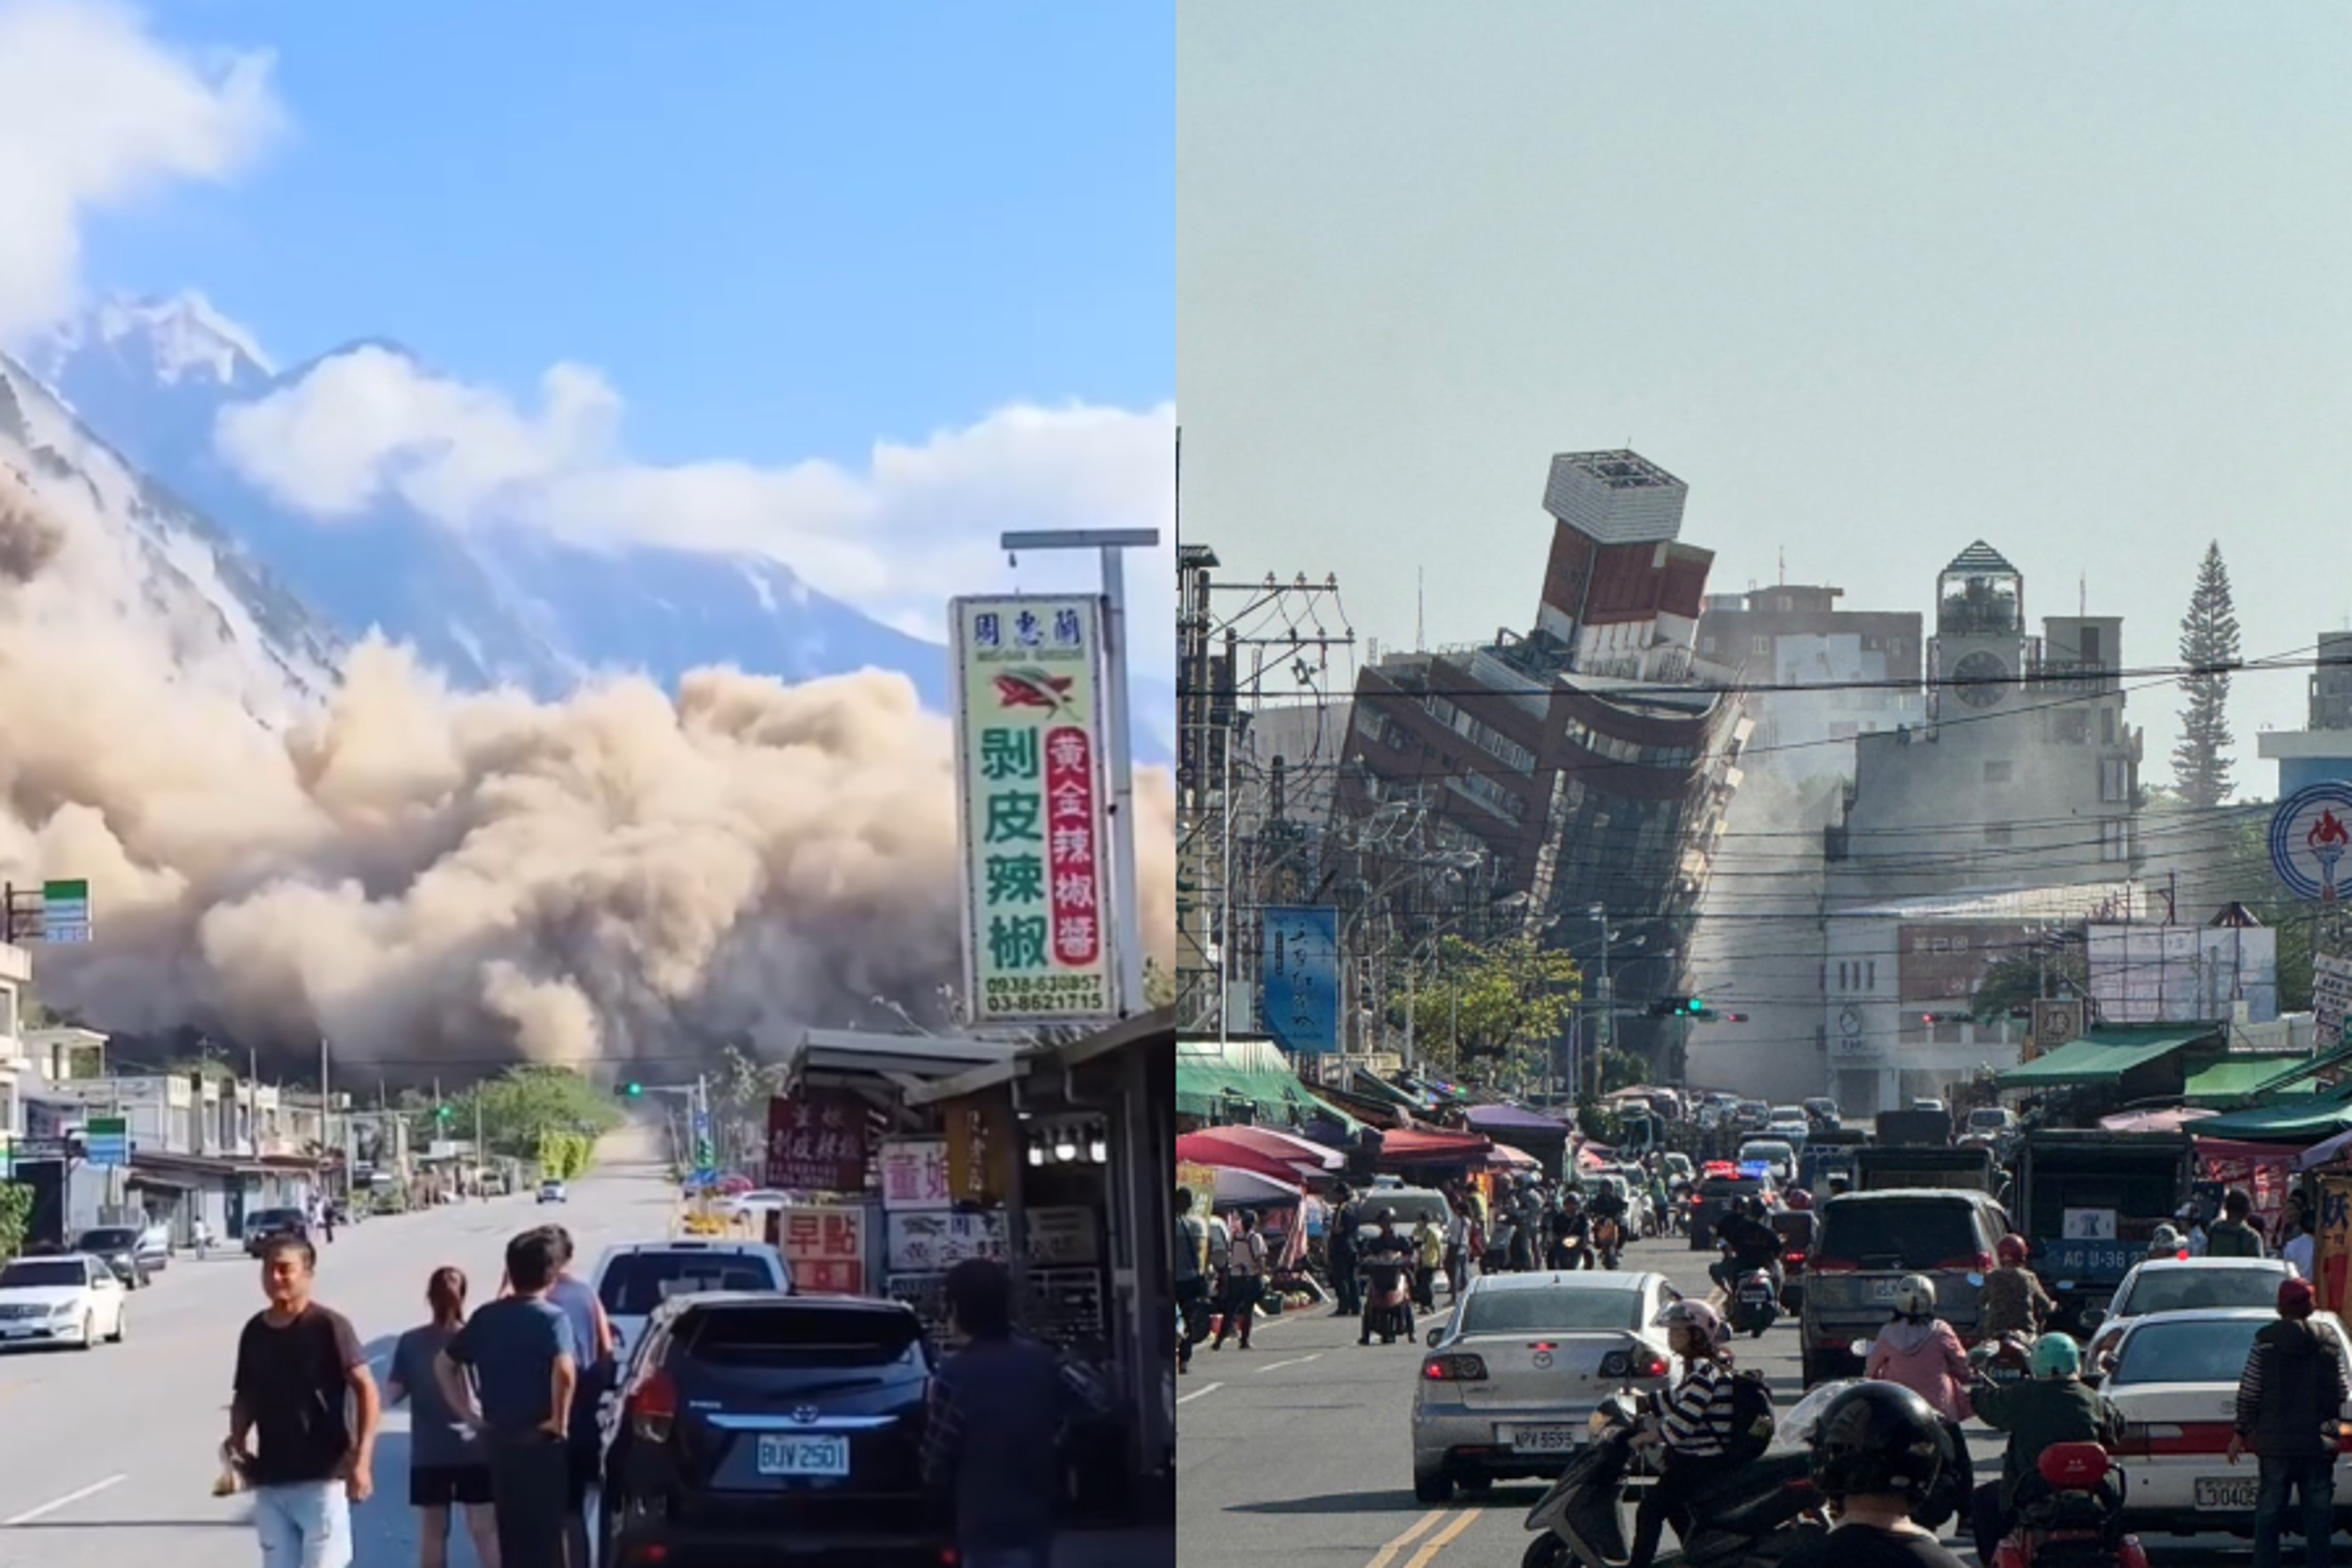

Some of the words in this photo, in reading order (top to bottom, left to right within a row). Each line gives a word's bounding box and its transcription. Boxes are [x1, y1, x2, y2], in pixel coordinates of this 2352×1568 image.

[981, 726, 1049, 969] 剝皮辣椒
[1050, 733, 1096, 957] 黃金辣椒醬
[787, 1214, 857, 1255] 早點
